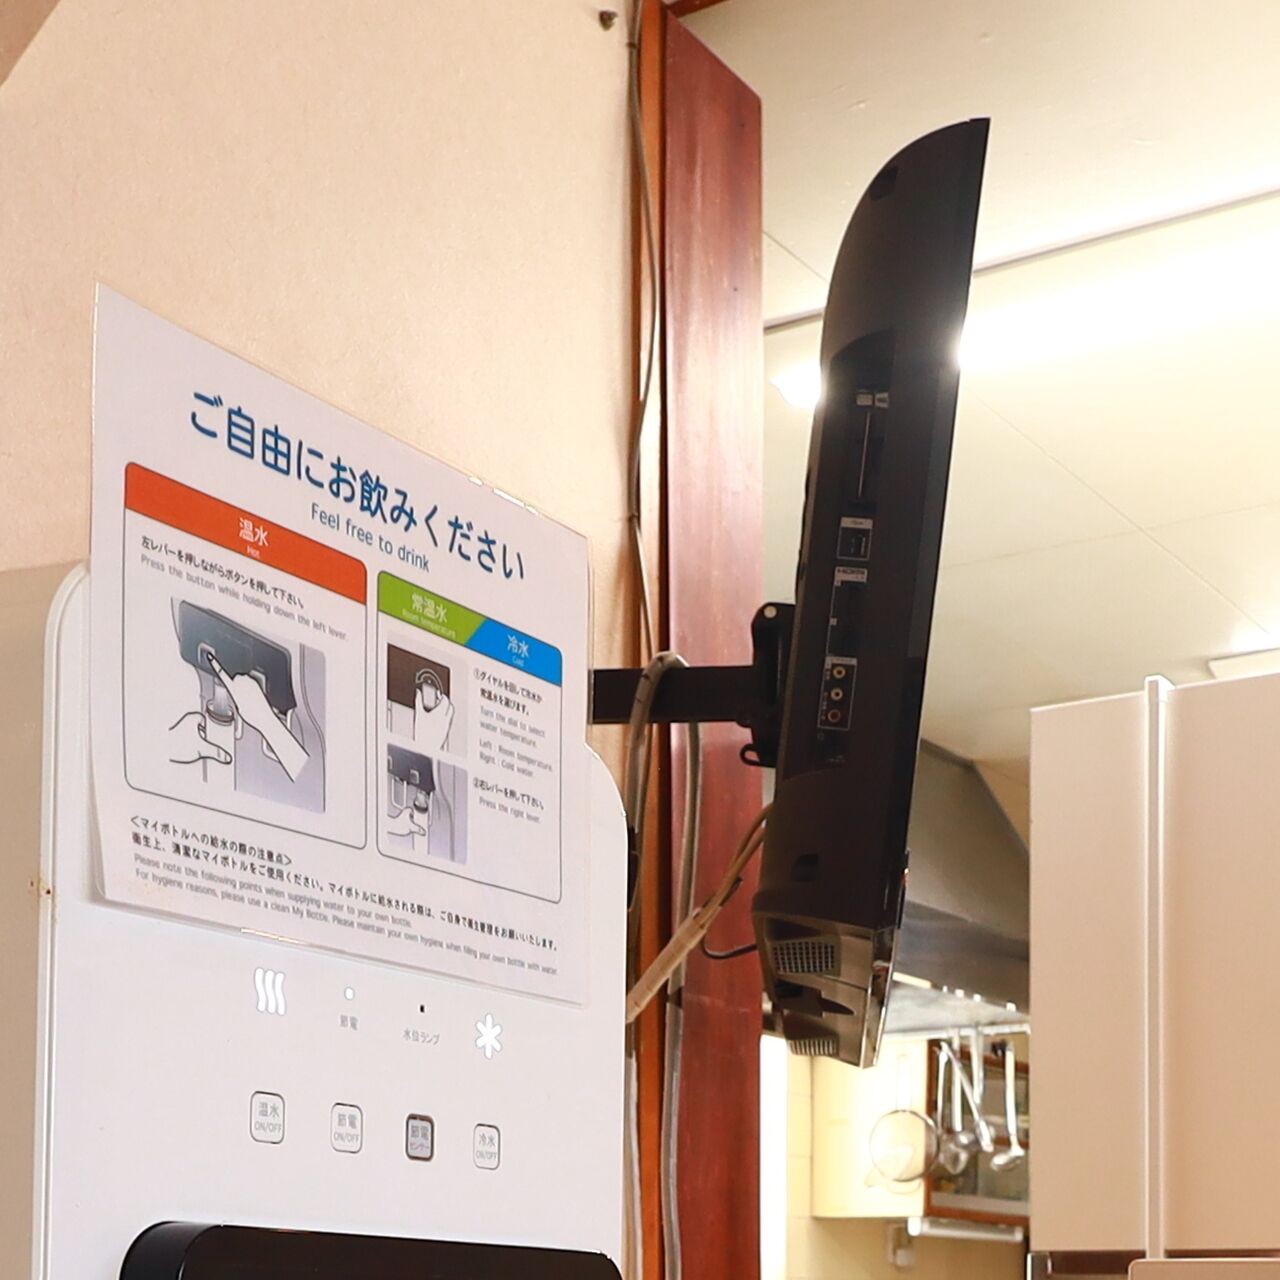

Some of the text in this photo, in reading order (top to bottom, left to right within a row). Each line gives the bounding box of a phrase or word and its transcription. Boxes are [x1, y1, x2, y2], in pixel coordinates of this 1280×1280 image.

[189, 381, 524, 588] ご自由にお飲みください
[239, 515, 268, 549] 温水
[311, 502, 429, 571] Feel free to drink
[141, 532, 303, 610] 左レバーを押しながらボタンを押して下さい。
[141, 553, 164, 571] Press
[168, 564, 182, 578] the
[186, 571, 214, 591] button
[218, 583, 239, 600] while
[242, 593, 270, 614] holding
[274, 605, 294, 622] down
[297, 615, 309, 628] the
[313, 621, 325, 634] left
[411, 590, 447, 625] 常温水
[507, 632, 528, 659] 冷水
[253, 1120, 282, 1134] ON/OFF
